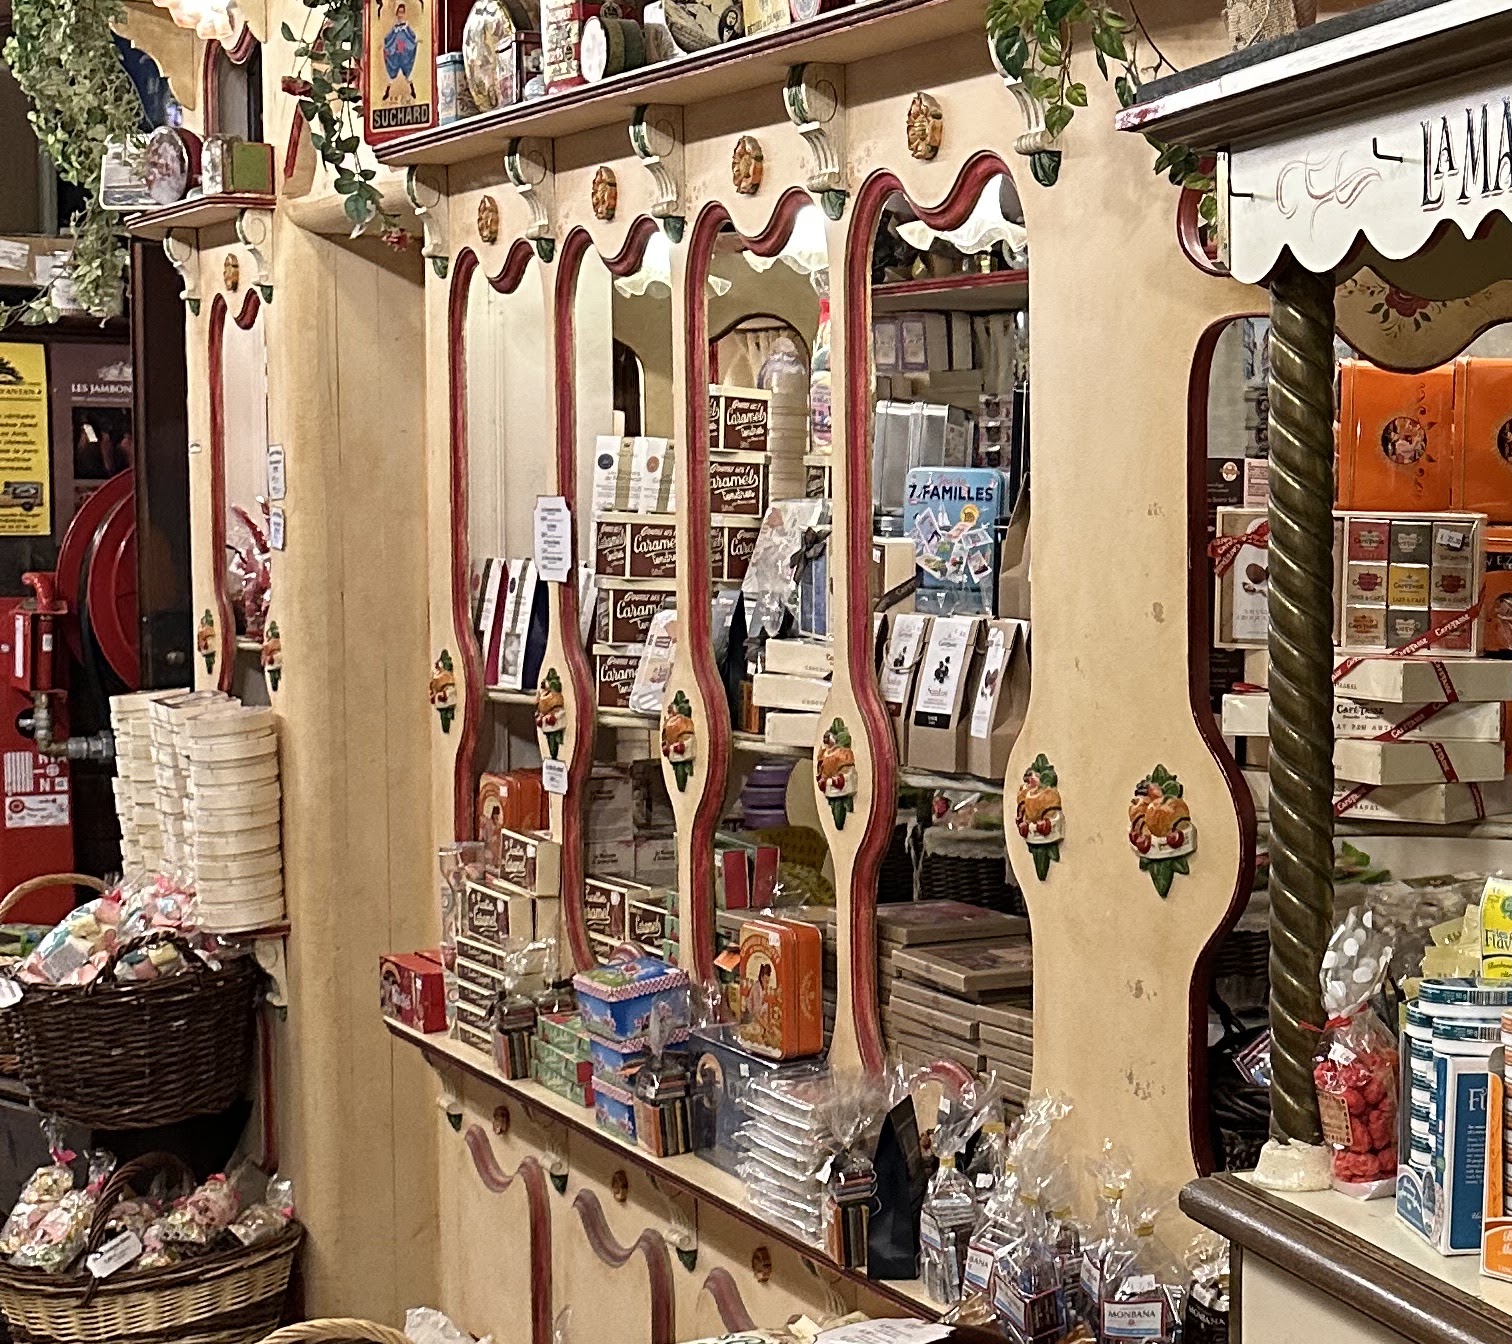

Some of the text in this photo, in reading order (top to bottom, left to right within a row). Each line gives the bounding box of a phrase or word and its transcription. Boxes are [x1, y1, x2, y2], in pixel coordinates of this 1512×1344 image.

[374, 105, 429, 129] SUCHARD
[1421, 115, 1458, 209] LA
[72, 383, 132, 395] LES JAMBON
[710, 467, 759, 491] aramels
[908, 484, 993, 502] 7 FAMILLES
[633, 534, 675, 554] Carame
[1108, 1309, 1157, 1320] MONBANA
